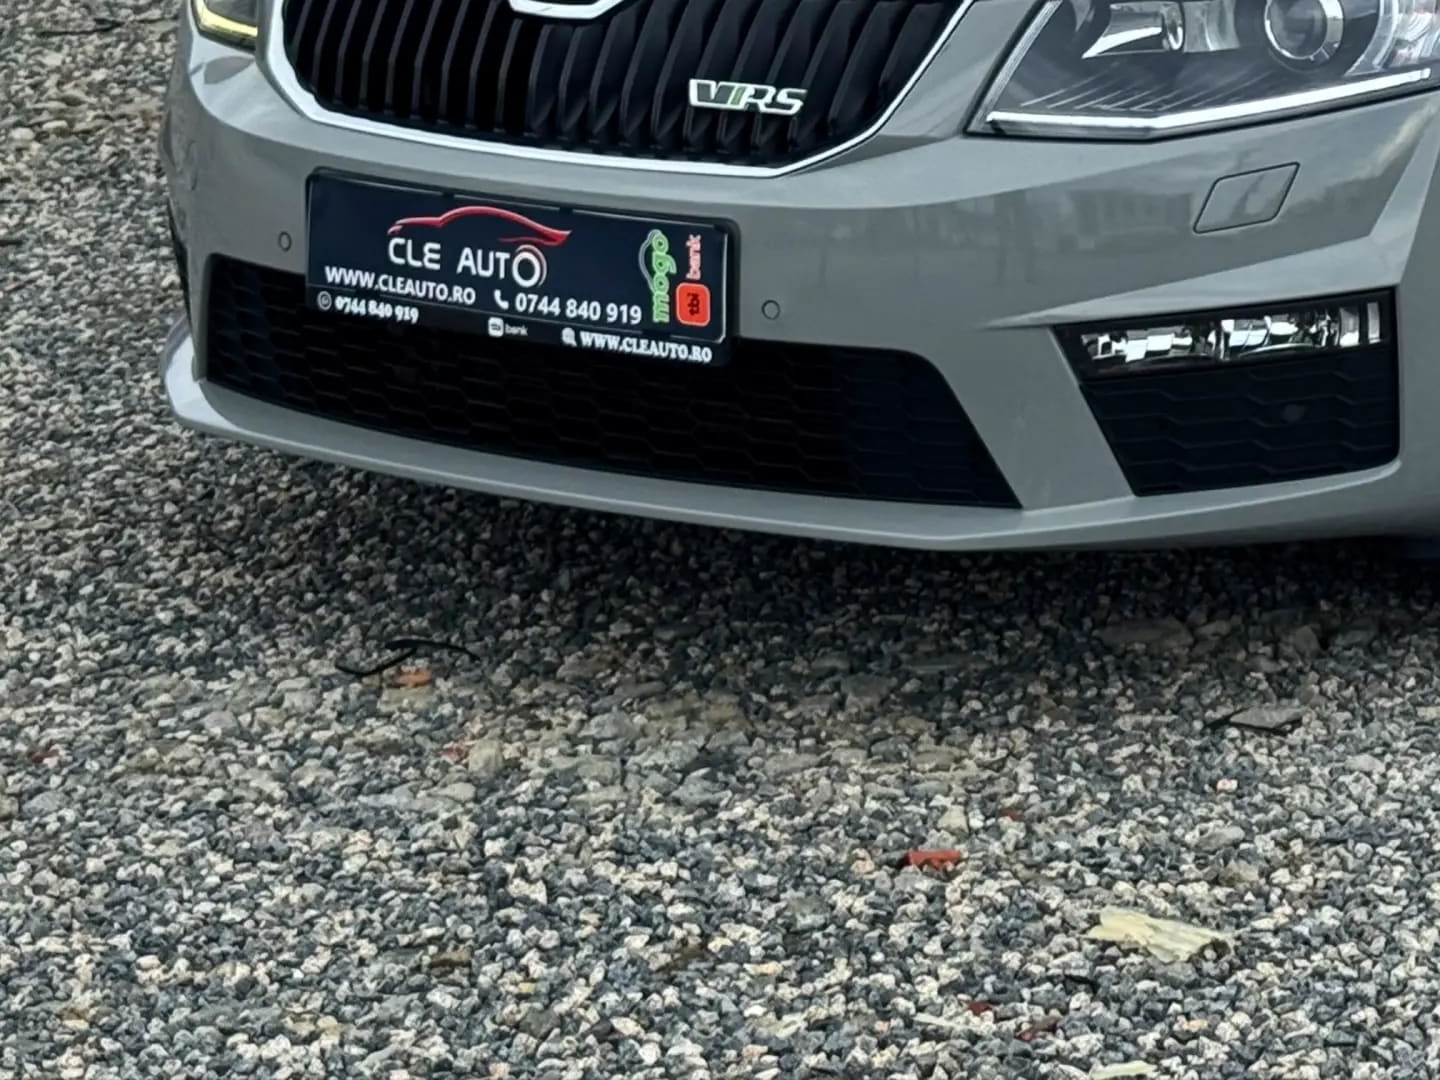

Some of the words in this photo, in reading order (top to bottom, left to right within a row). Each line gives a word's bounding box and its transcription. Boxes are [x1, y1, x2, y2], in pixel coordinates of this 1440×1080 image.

[388, 237, 441, 270] CLE
[456, 247, 541, 288] AUTO
[652, 233, 677, 323] mogo
[324, 265, 476, 306] WWW.CLEAUTO.RO
[333, 295, 368, 315] 0744
[367, 300, 393, 319] 840
[394, 306, 420, 325] 919
[515, 292, 561, 317] 0744
[565, 298, 601, 321] 840
[606, 302, 642, 325] 919
[579, 330, 713, 364] WWW.CLEAUTO.RO
